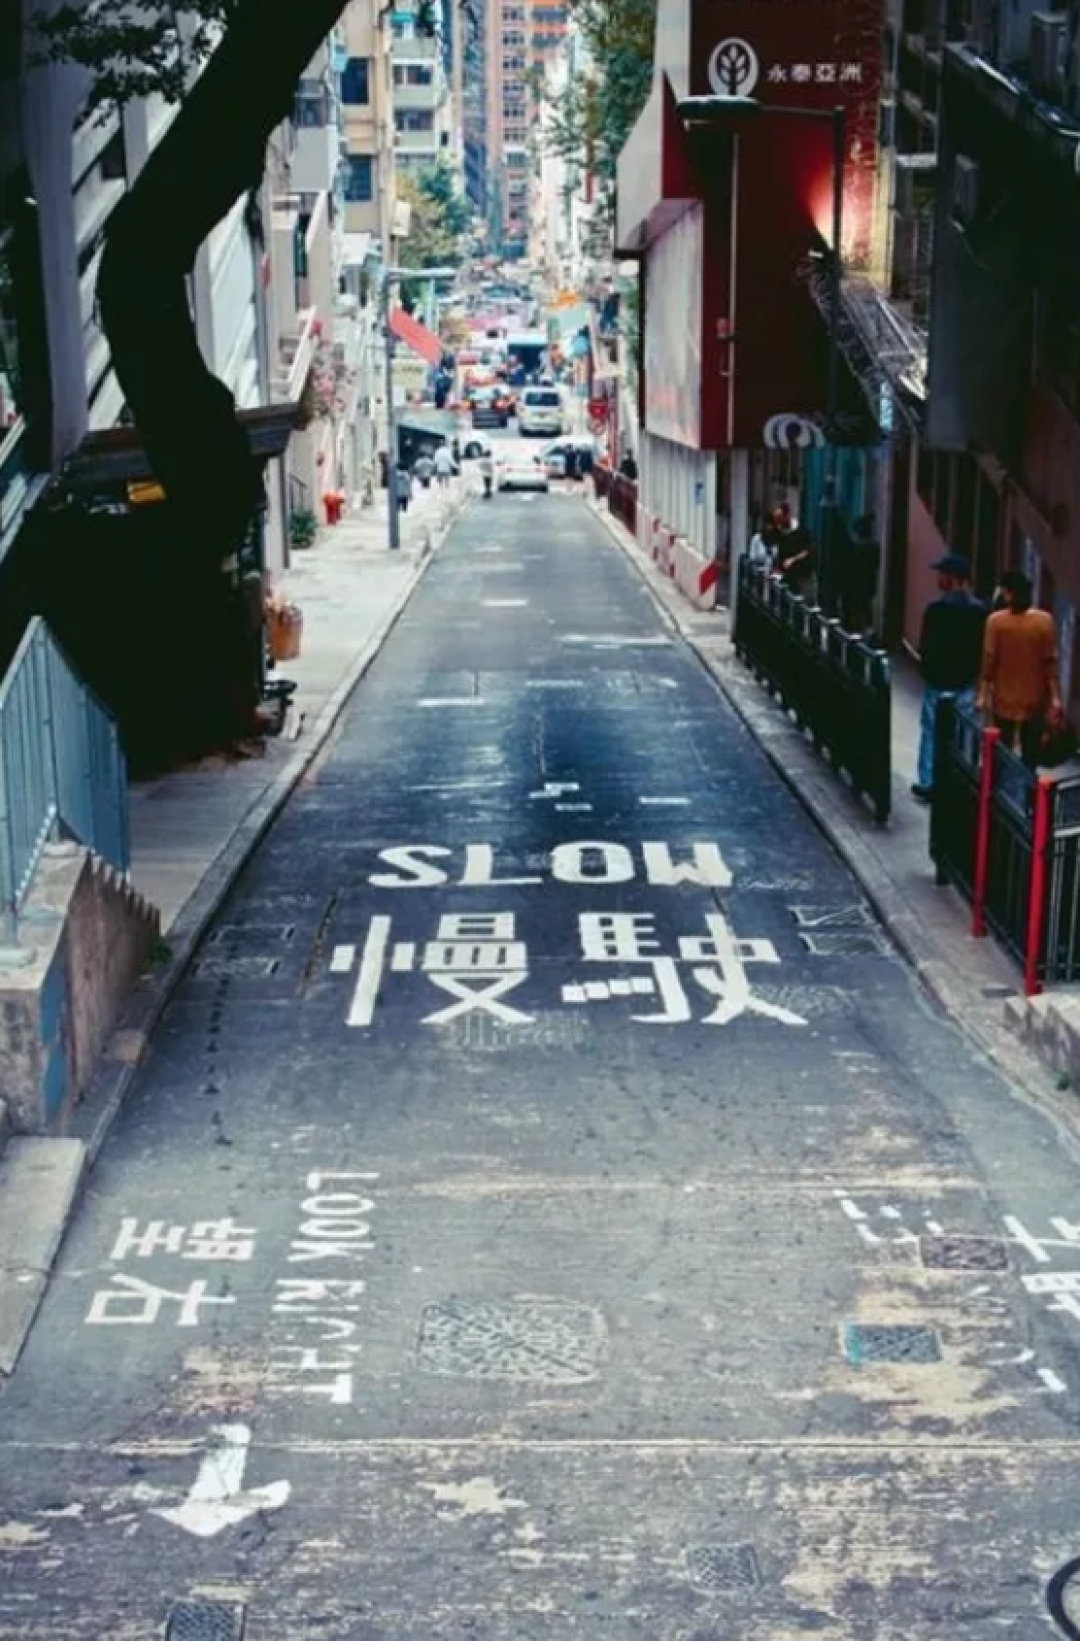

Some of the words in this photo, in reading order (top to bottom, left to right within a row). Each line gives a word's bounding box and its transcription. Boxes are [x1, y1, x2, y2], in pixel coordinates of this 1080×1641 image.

[368, 840, 733, 887] SLOW
[329, 911, 809, 1027] 慢駛
[287, 1171, 381, 1262] LOOK
[84, 1217, 257, 1326] 望右
